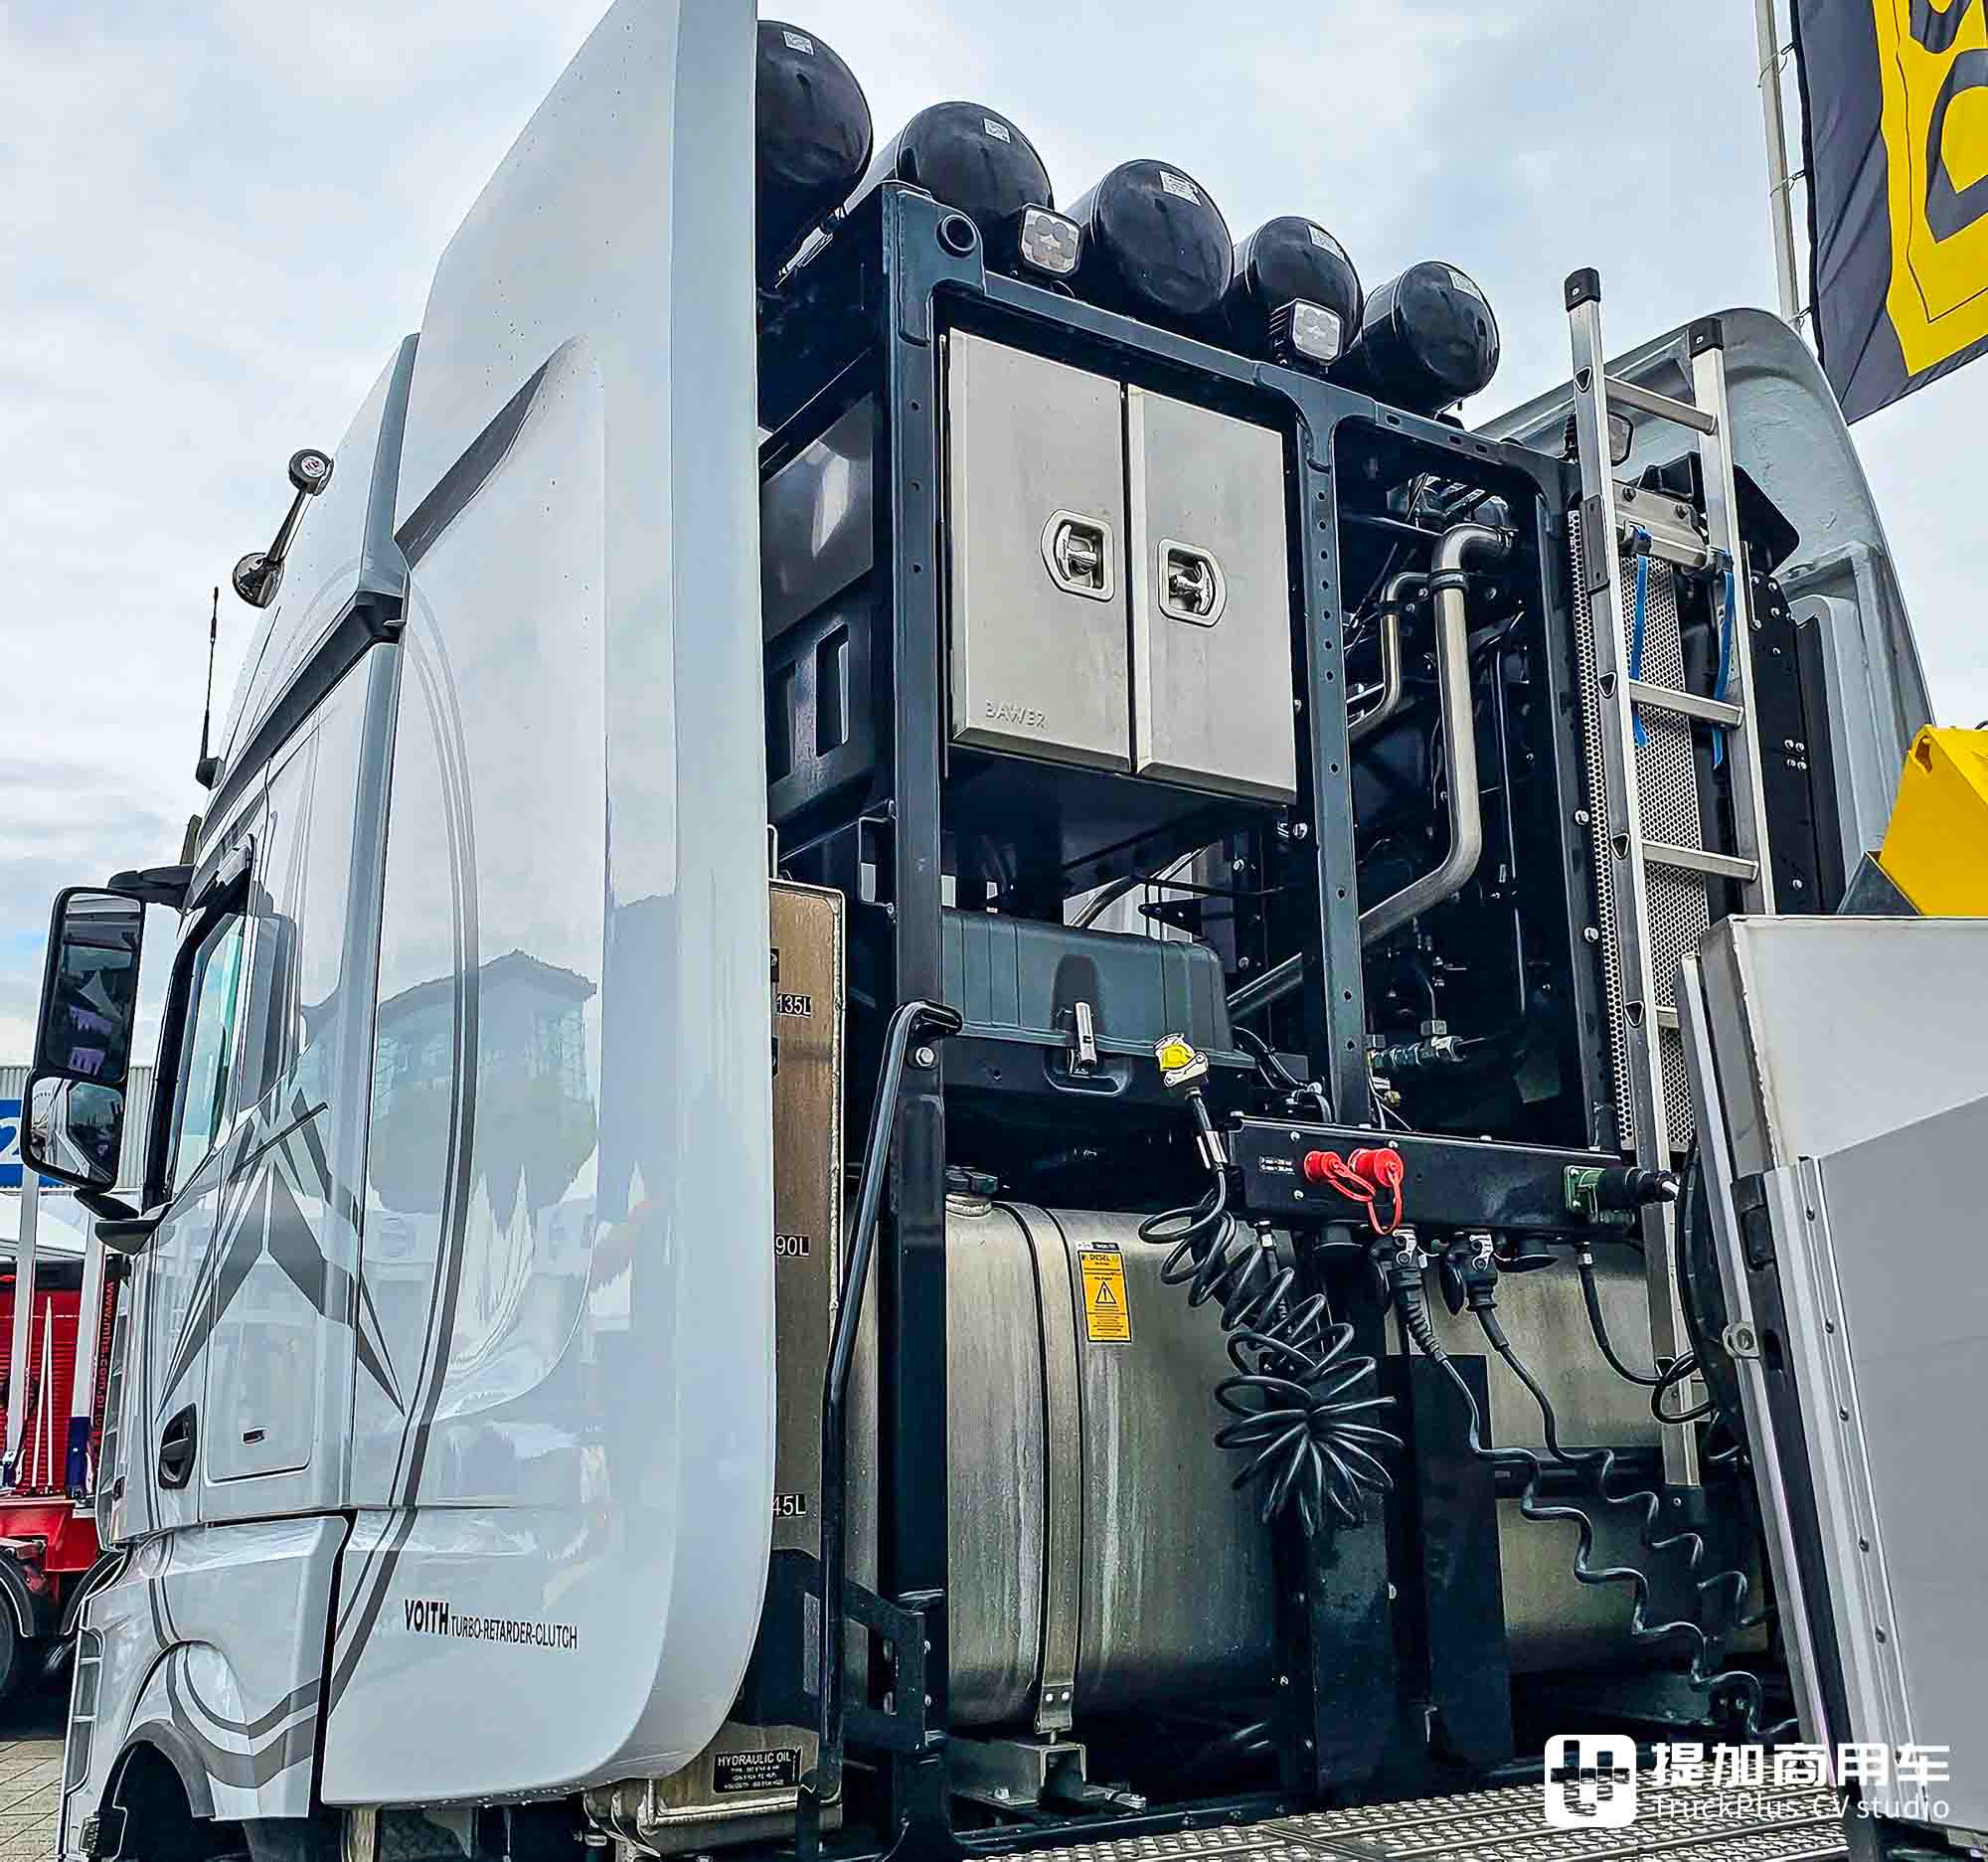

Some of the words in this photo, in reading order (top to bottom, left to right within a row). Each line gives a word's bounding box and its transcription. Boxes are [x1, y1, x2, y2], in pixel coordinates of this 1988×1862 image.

[986, 700, 1048, 730] BAWER
[776, 994, 811, 1015] 135L
[775, 1236, 809, 1256] 90L
[772, 1494, 806, 1516] 45L
[405, 1599, 448, 1634] VOITH
[450, 1615, 578, 1649] TURBO-RETARDER-CLUTCH
[718, 1752, 774, 1767] HYDRAULIC
[776, 1751, 791, 1763] OIL
